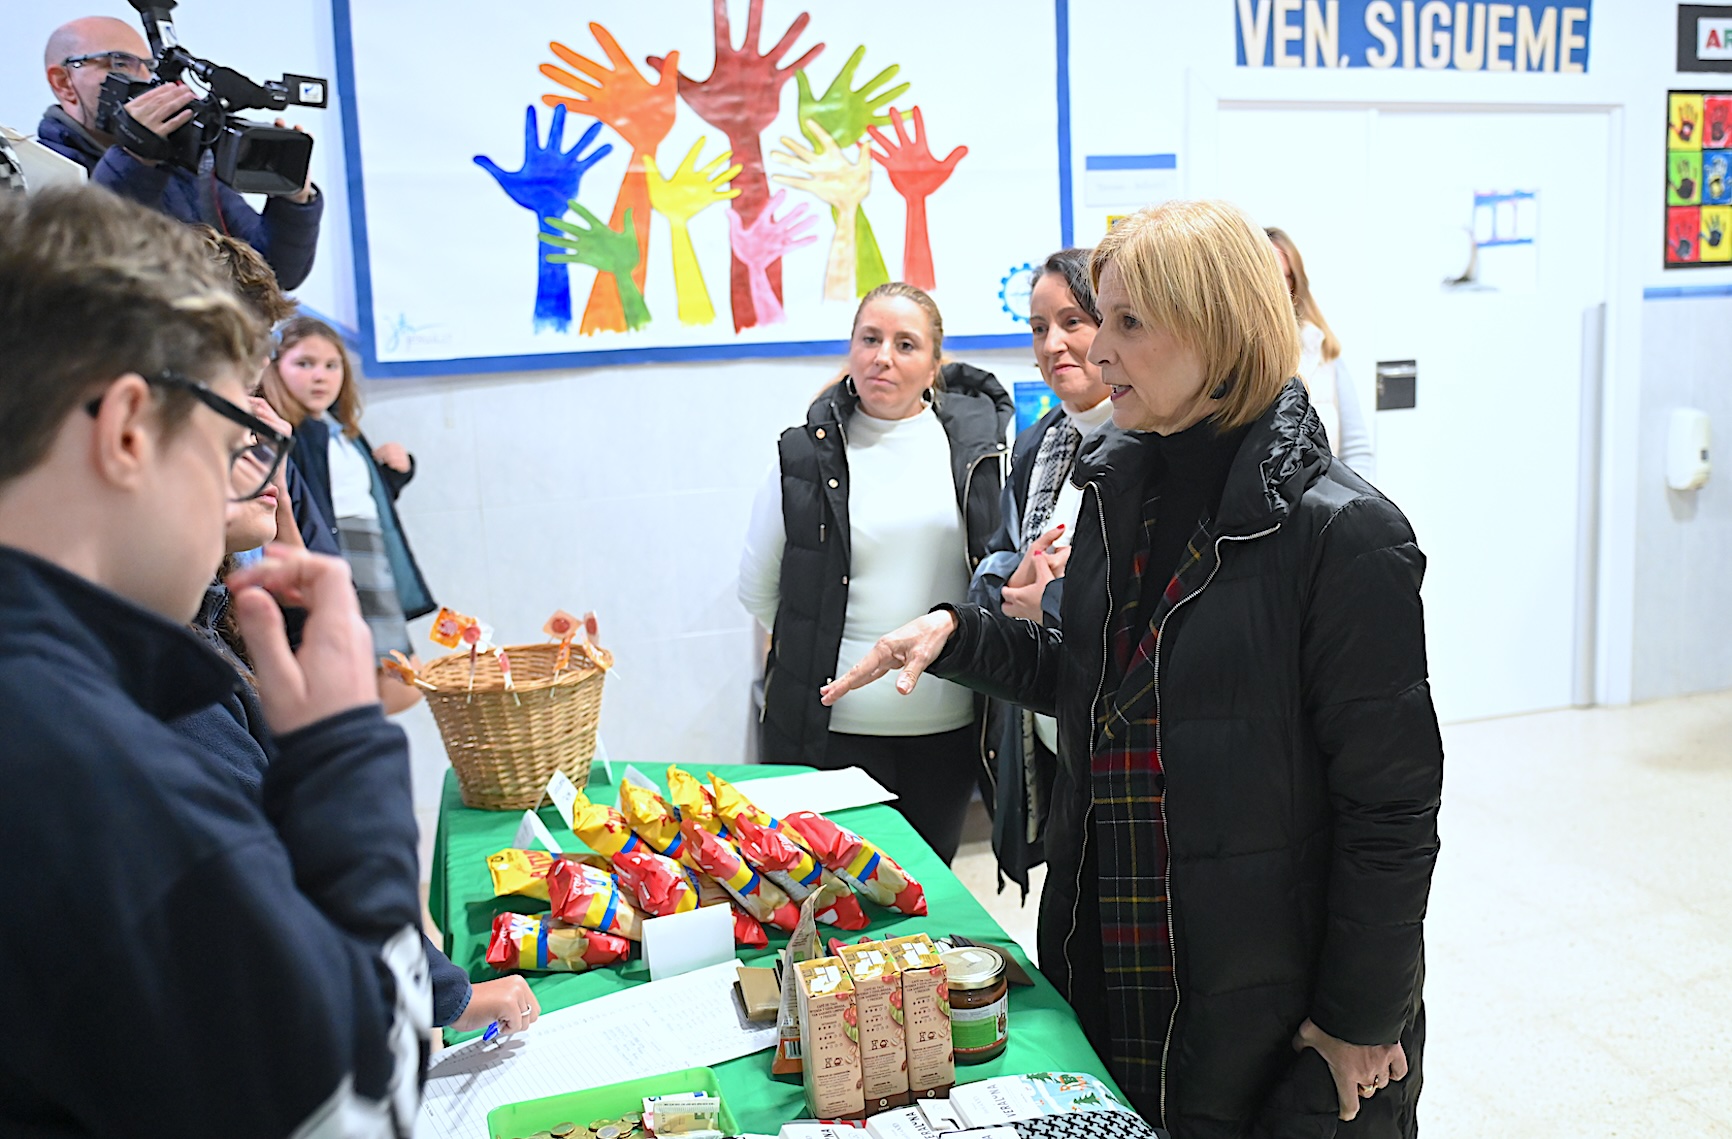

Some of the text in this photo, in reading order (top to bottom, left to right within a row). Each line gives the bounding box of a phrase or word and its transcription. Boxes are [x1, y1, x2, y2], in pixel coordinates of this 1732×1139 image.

[1238, 0, 1588, 72] VEN, SIGUEME
[905, 1111, 939, 1139] ERALUNA
